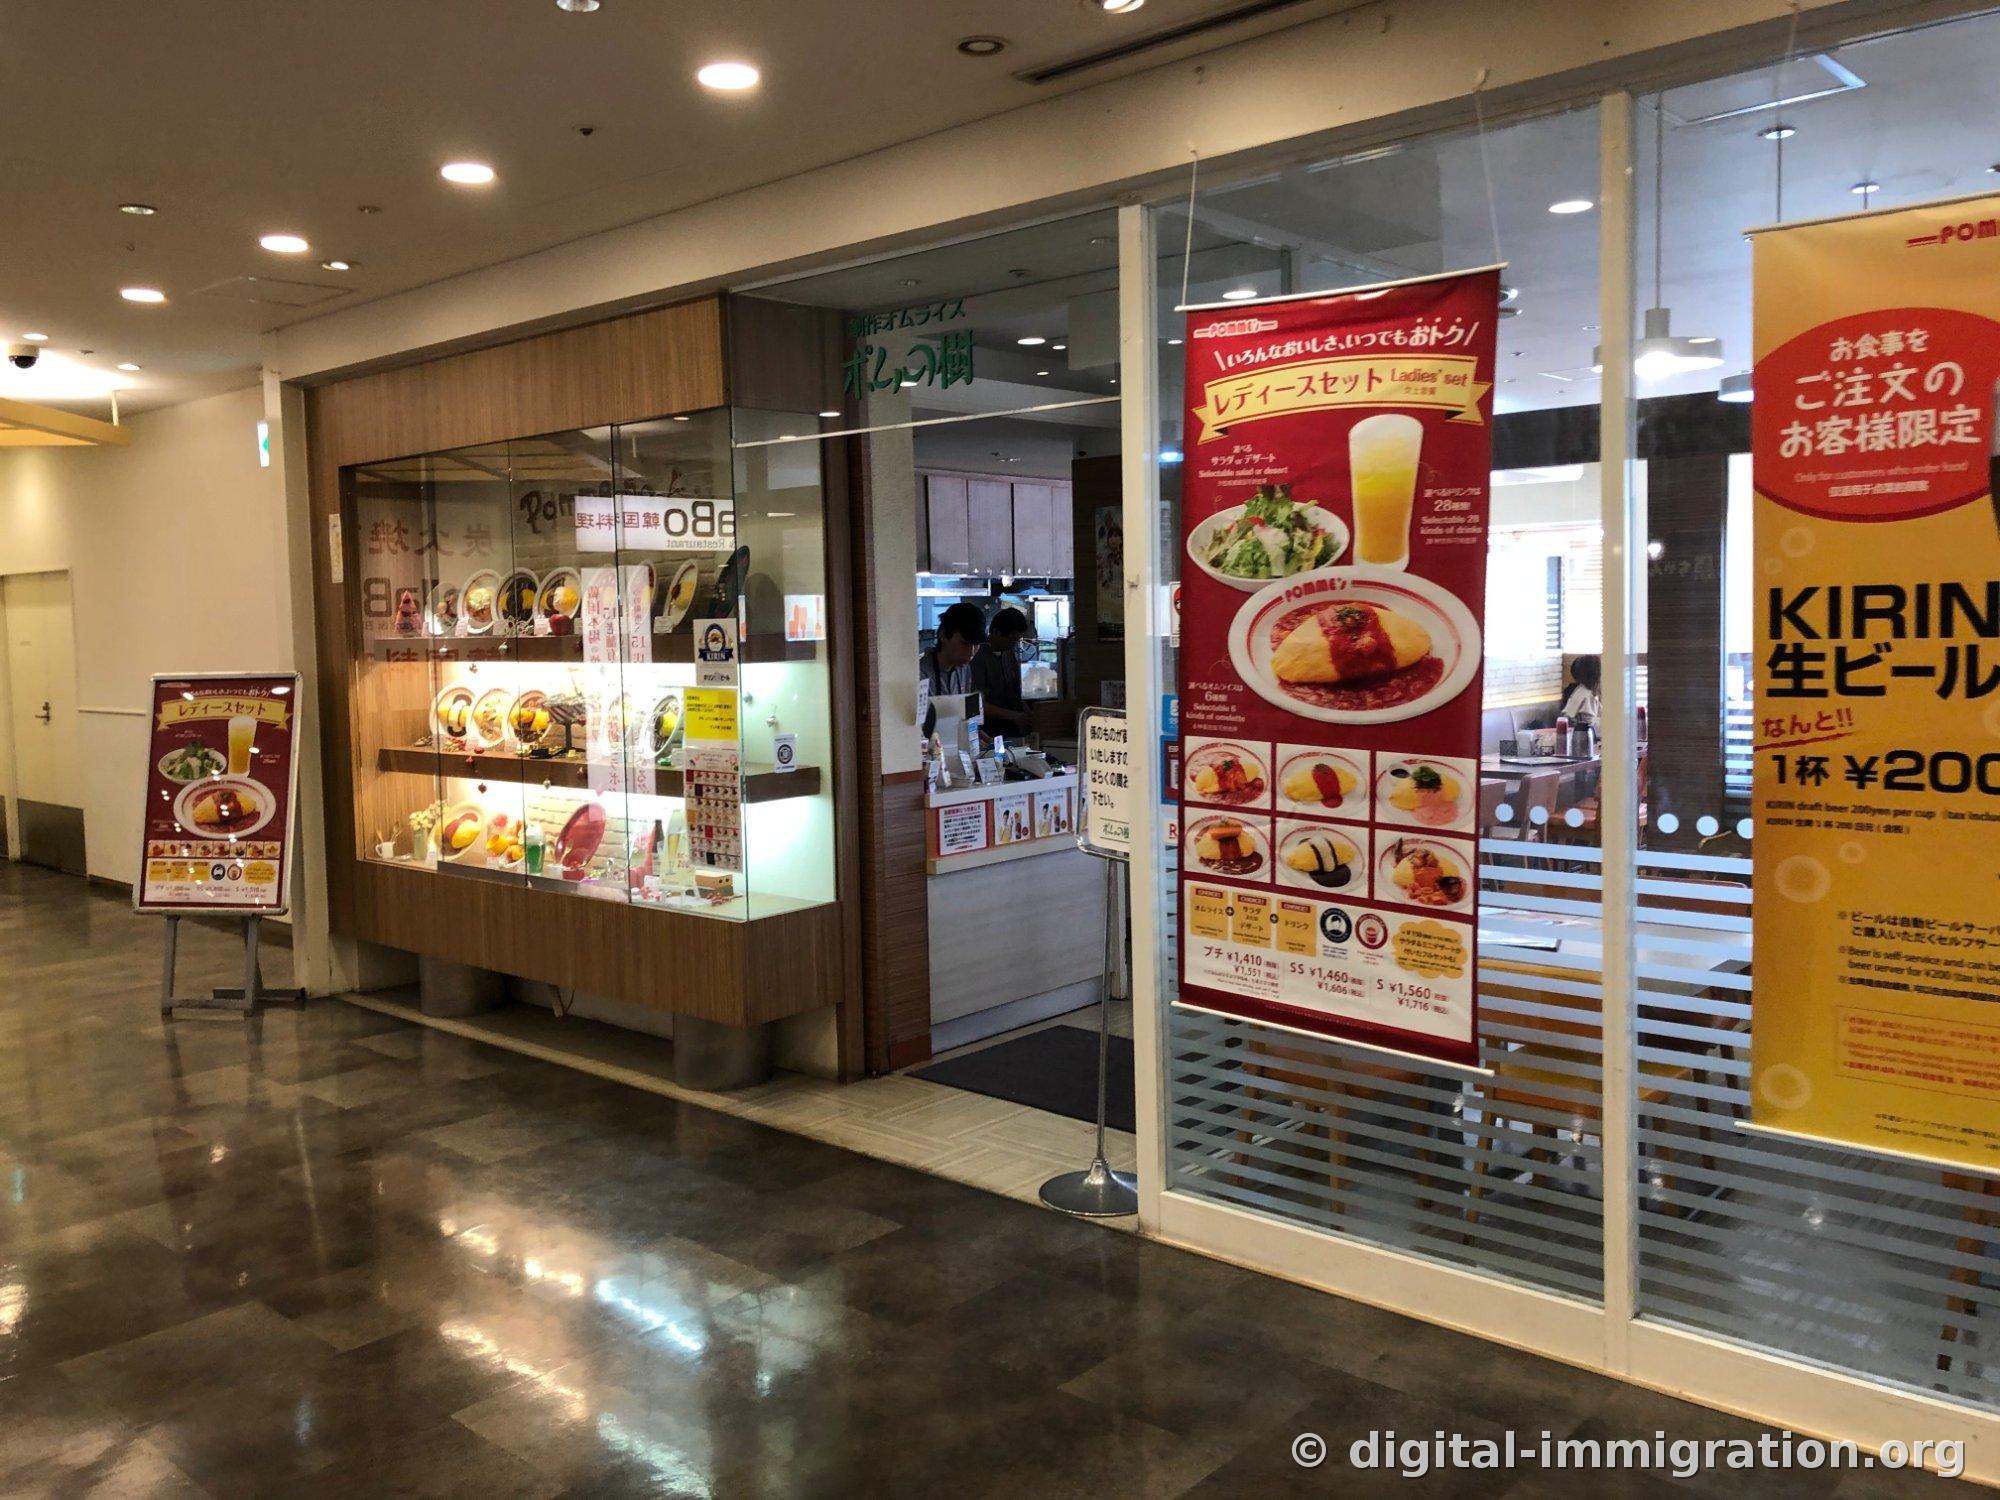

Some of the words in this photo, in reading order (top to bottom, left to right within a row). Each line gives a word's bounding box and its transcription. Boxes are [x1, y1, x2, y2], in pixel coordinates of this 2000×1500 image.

[1829, 328, 1930, 362] お食事を
[1443, 371, 1468, 387] set
[1794, 361, 1965, 411] ご注文の
[1213, 367, 1382, 417] レディースセット
[1779, 404, 1983, 458] お客様限定
[1768, 580, 2000, 640] KIRIN
[705, 650, 727, 662] KIRIN
[1766, 641, 2000, 701] 生ビール
[178, 701, 267, 718] レディースセット
[1761, 707, 1854, 738] なんと!!
[1770, 755, 1830, 787] 1杯
[1825, 802, 1849, 813] beer
[1227, 951, 1262, 967] ¥1,410
[1233, 964, 1262, 978] ¥1,551
[1309, 966, 1348, 984] ¥1,460
[1317, 982, 1348, 995] ¥1,606
[1376, 978, 1384, 990] S
[1389, 983, 1431, 1000] ¥1,560
[1397, 997, 1430, 1012] ¥1,716
